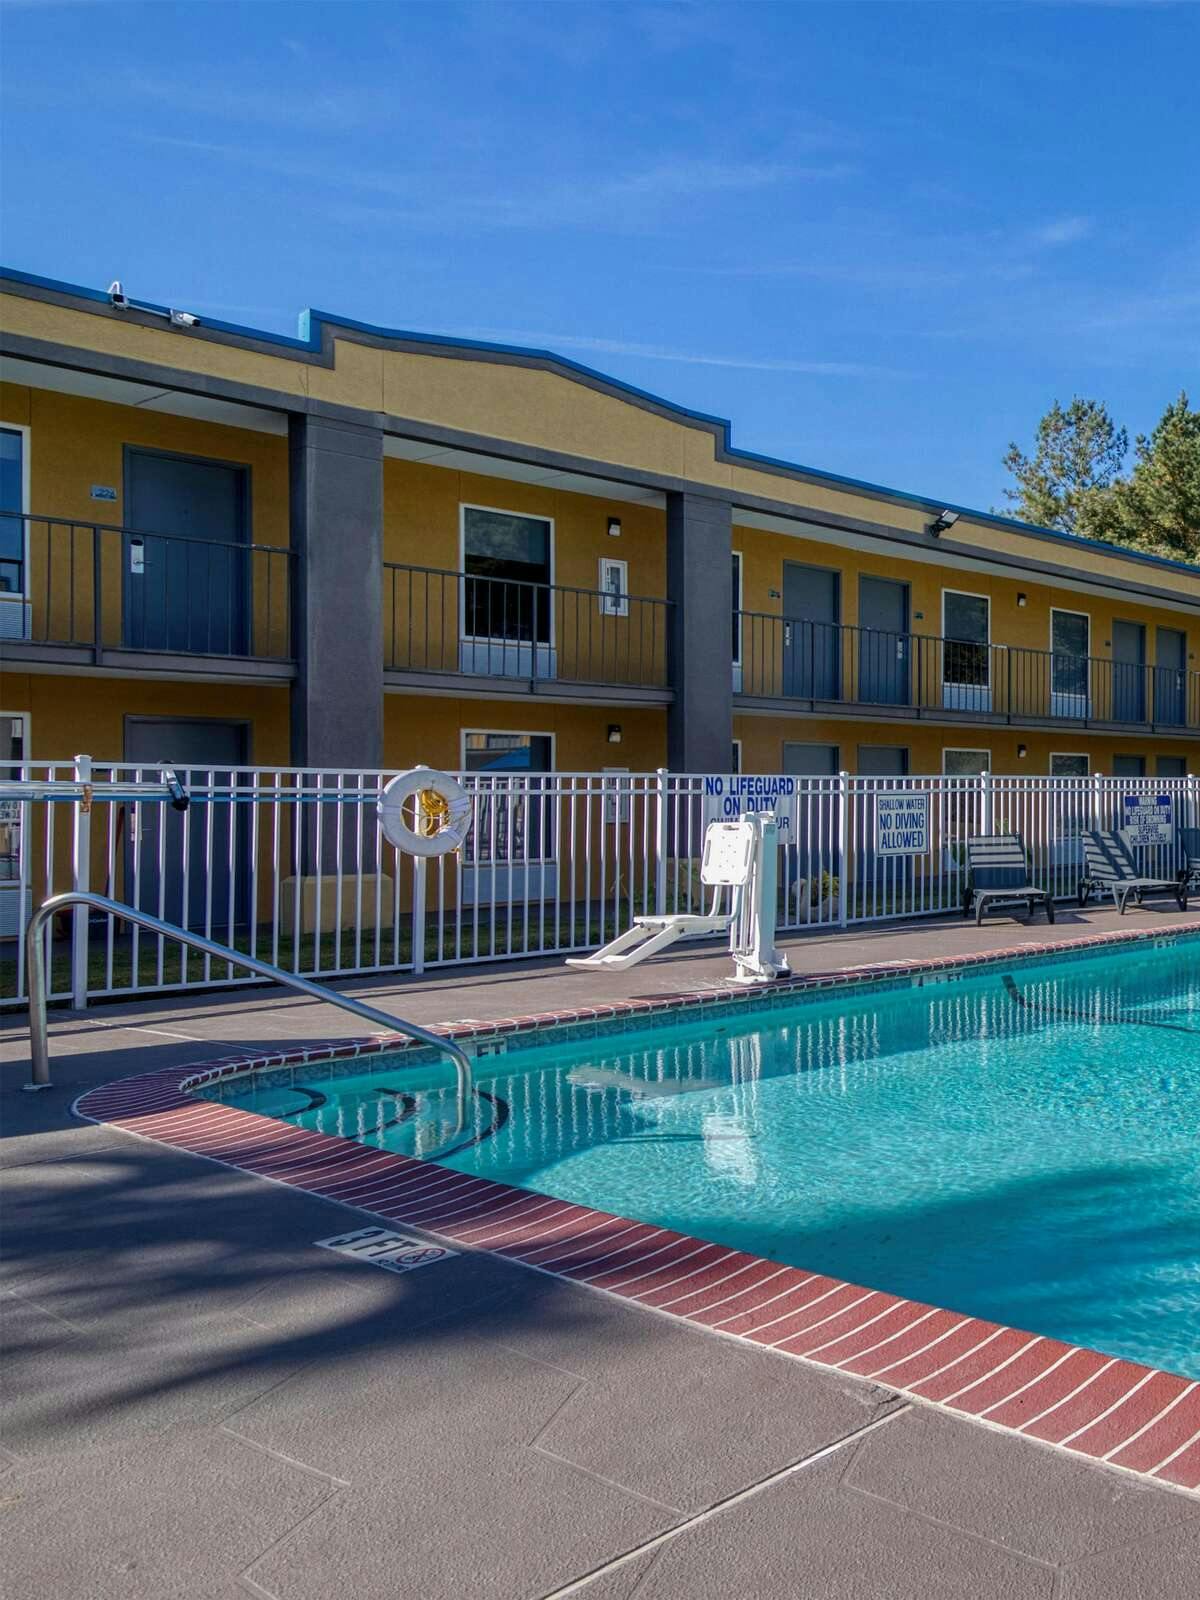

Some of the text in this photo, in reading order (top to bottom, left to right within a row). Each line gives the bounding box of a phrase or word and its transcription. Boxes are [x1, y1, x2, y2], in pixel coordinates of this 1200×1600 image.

[705, 777, 794, 795] NO LIFEGUARD
[724, 797, 777, 815] ON DUTY
[879, 798, 924, 811] SHALLOW WATER
[880, 812, 924, 830] NO DIVING
[881, 831, 924, 848] ALLOWED
[328, 1230, 420, 1257] 3 FT
